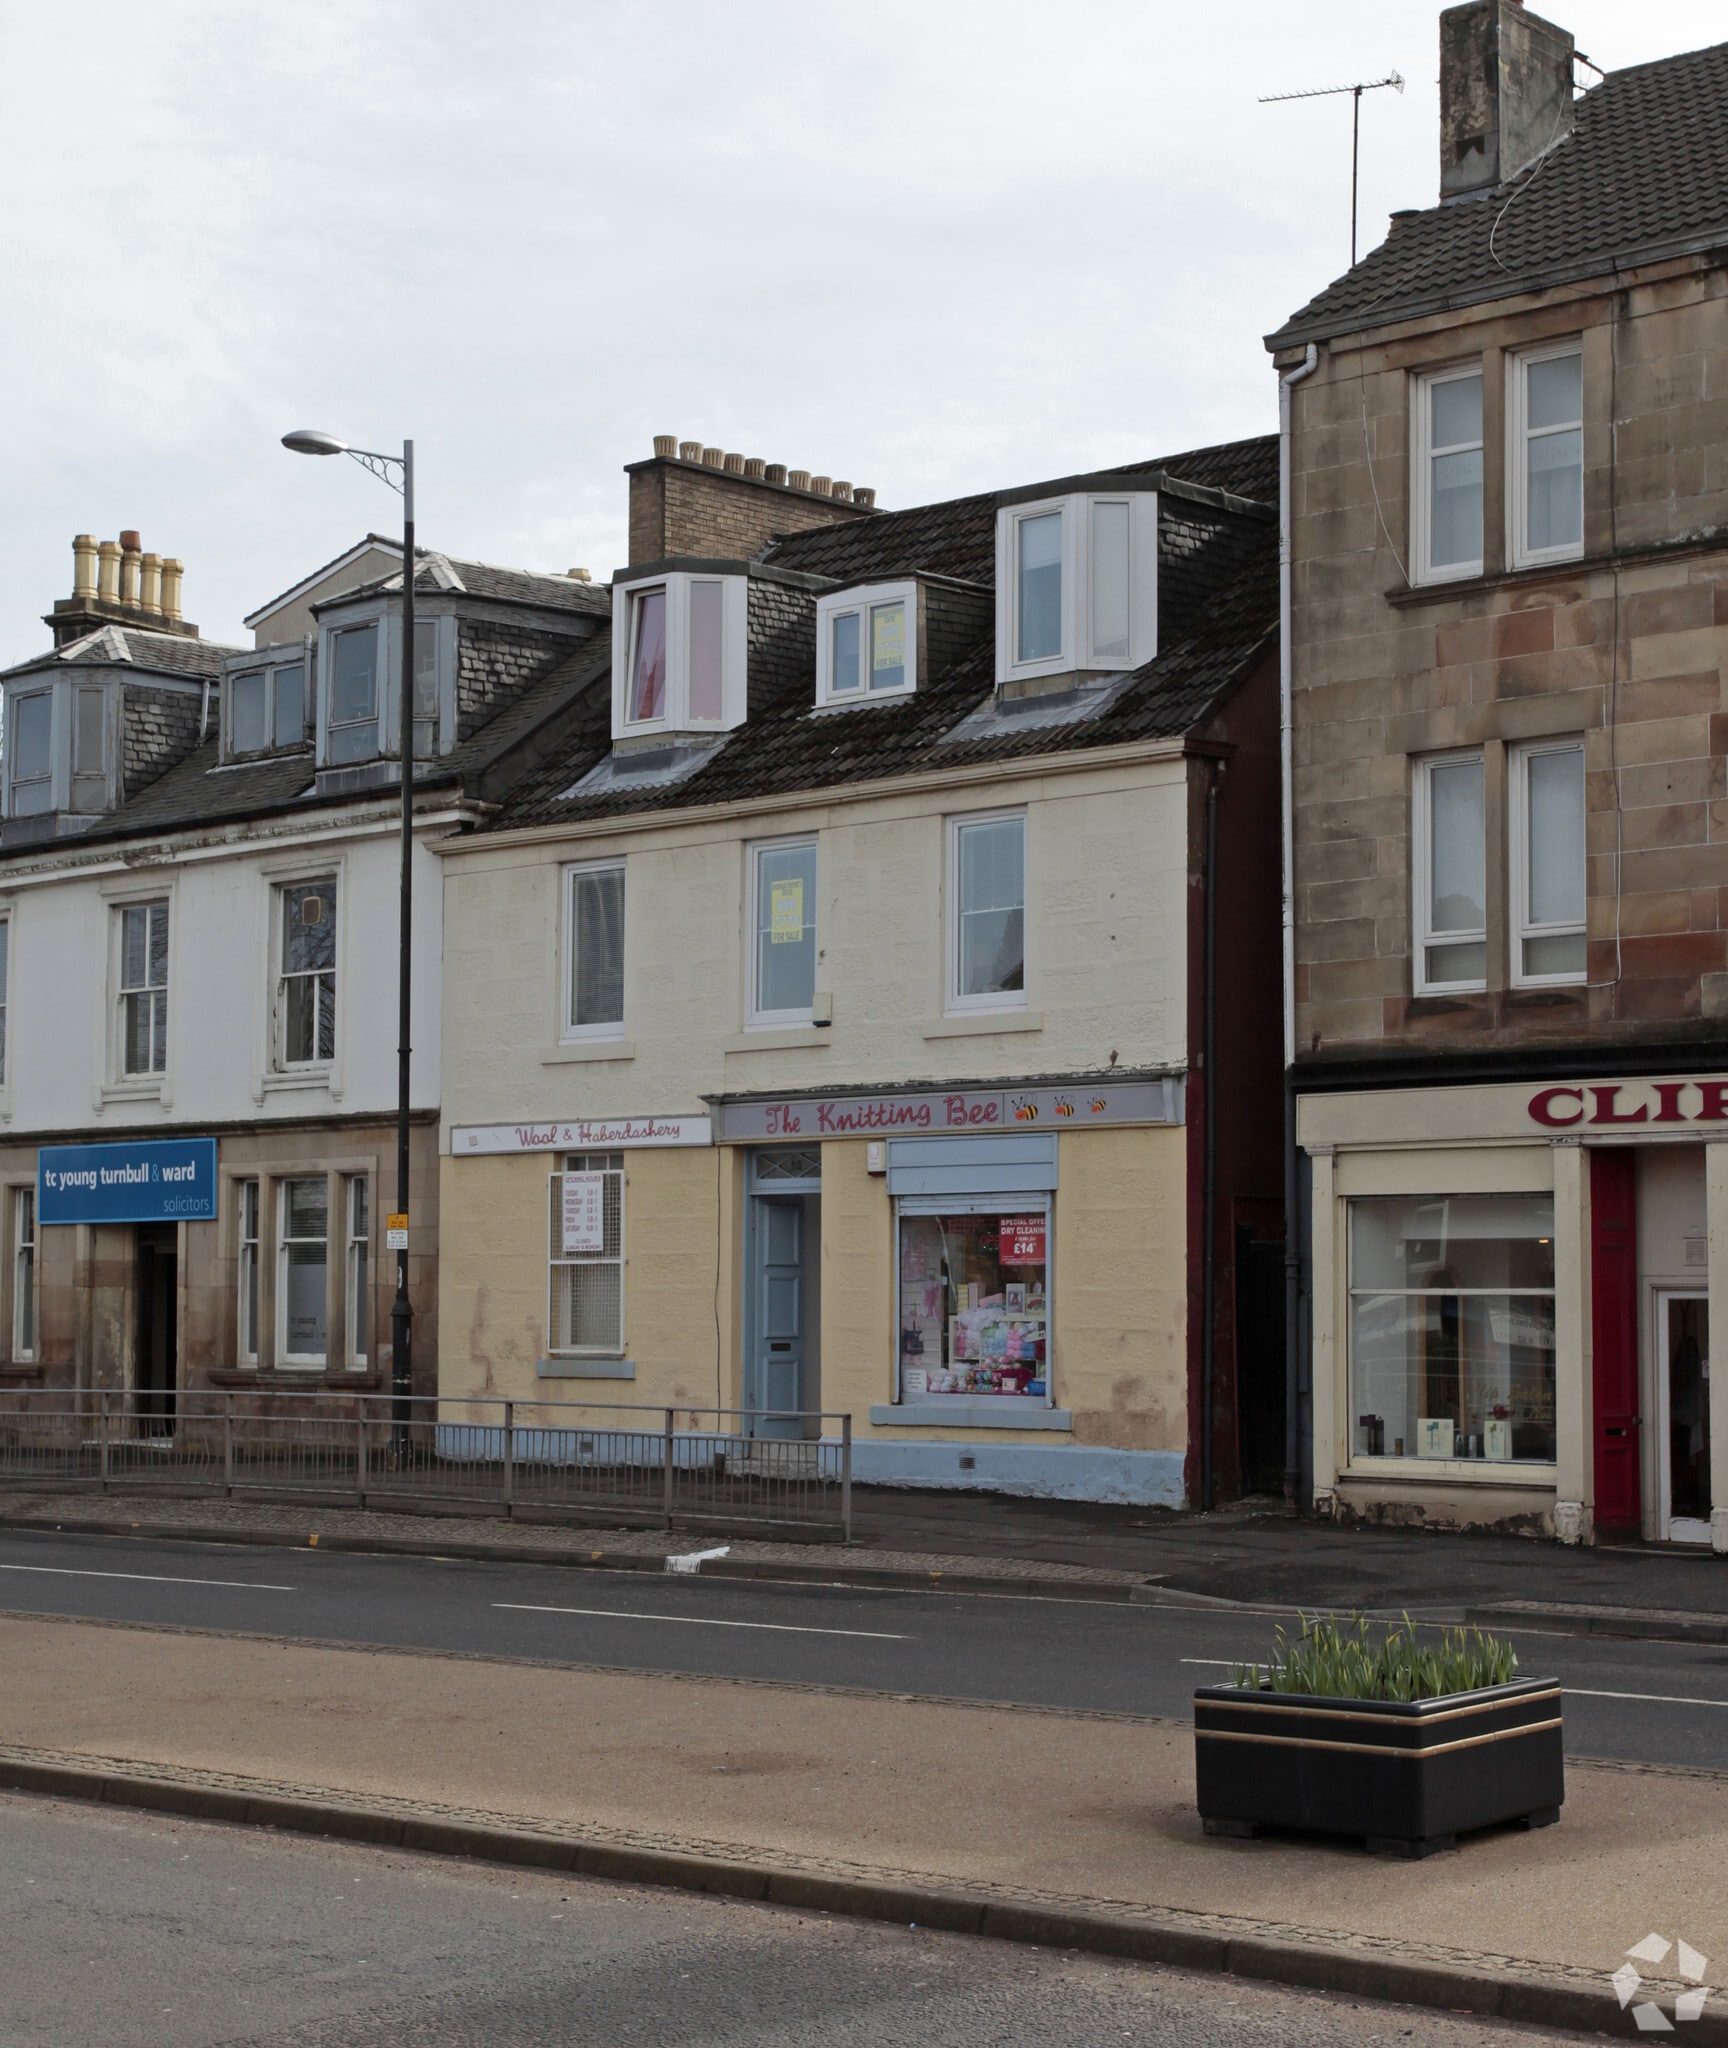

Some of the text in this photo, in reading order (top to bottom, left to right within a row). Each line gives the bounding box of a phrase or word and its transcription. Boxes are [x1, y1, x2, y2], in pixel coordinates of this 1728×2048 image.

[876, 655, 903, 668] FOR SALE
[773, 930, 800, 943] FOR SALE
[764, 1094, 1000, 1134] The Knitting Bee
[515, 1119, 680, 1147] Wool & Haberdashery
[45, 1160, 195, 1191] tc young turnbull & ward
[163, 1195, 210, 1213] solicitors
[1001, 1226, 1046, 1235] DRY CLEANIN
[979, 1234, 1000, 1248] OPE
